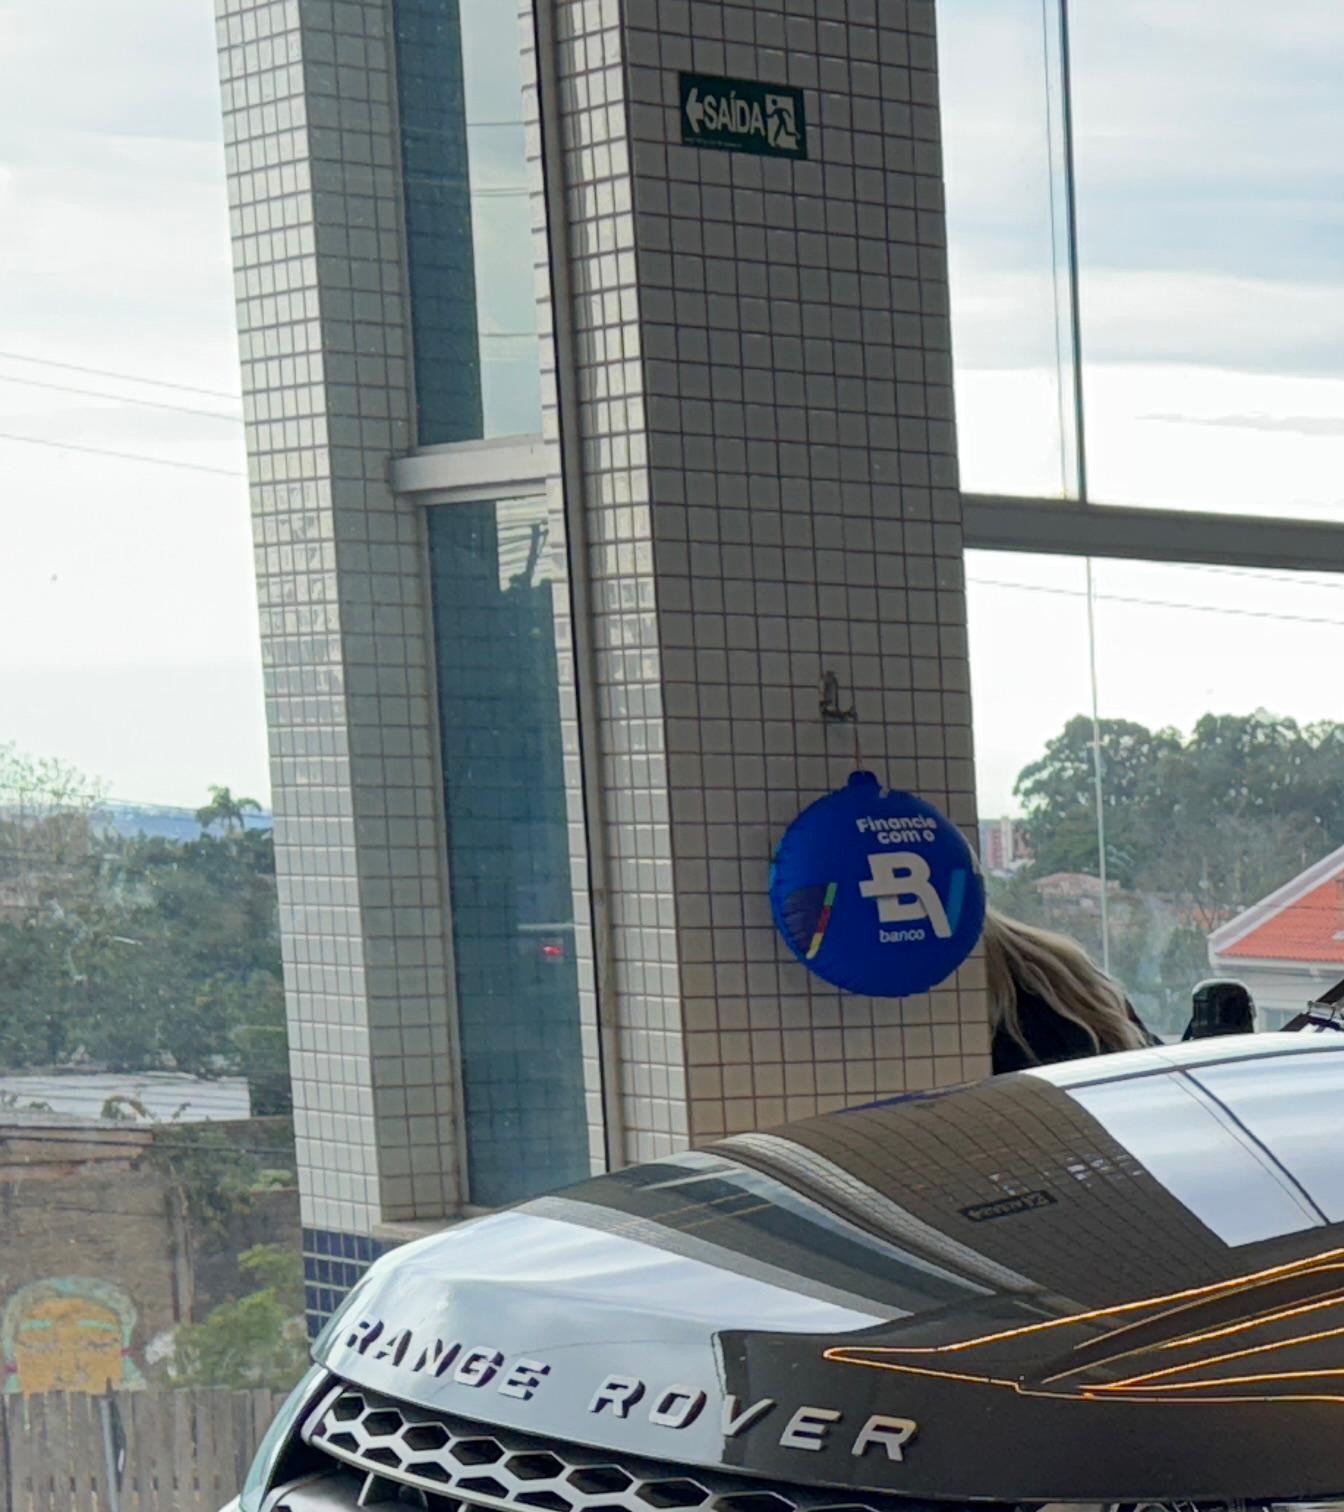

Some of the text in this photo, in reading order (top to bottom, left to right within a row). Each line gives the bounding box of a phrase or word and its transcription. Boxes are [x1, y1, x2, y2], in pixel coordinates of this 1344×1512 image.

[703, 90, 765, 136] SAÍDA
[856, 815, 937, 833] Financie
[878, 830, 935, 844] com o
[880, 929, 925, 943] banco
[343, 1314, 918, 1462] RANGE ROVER
